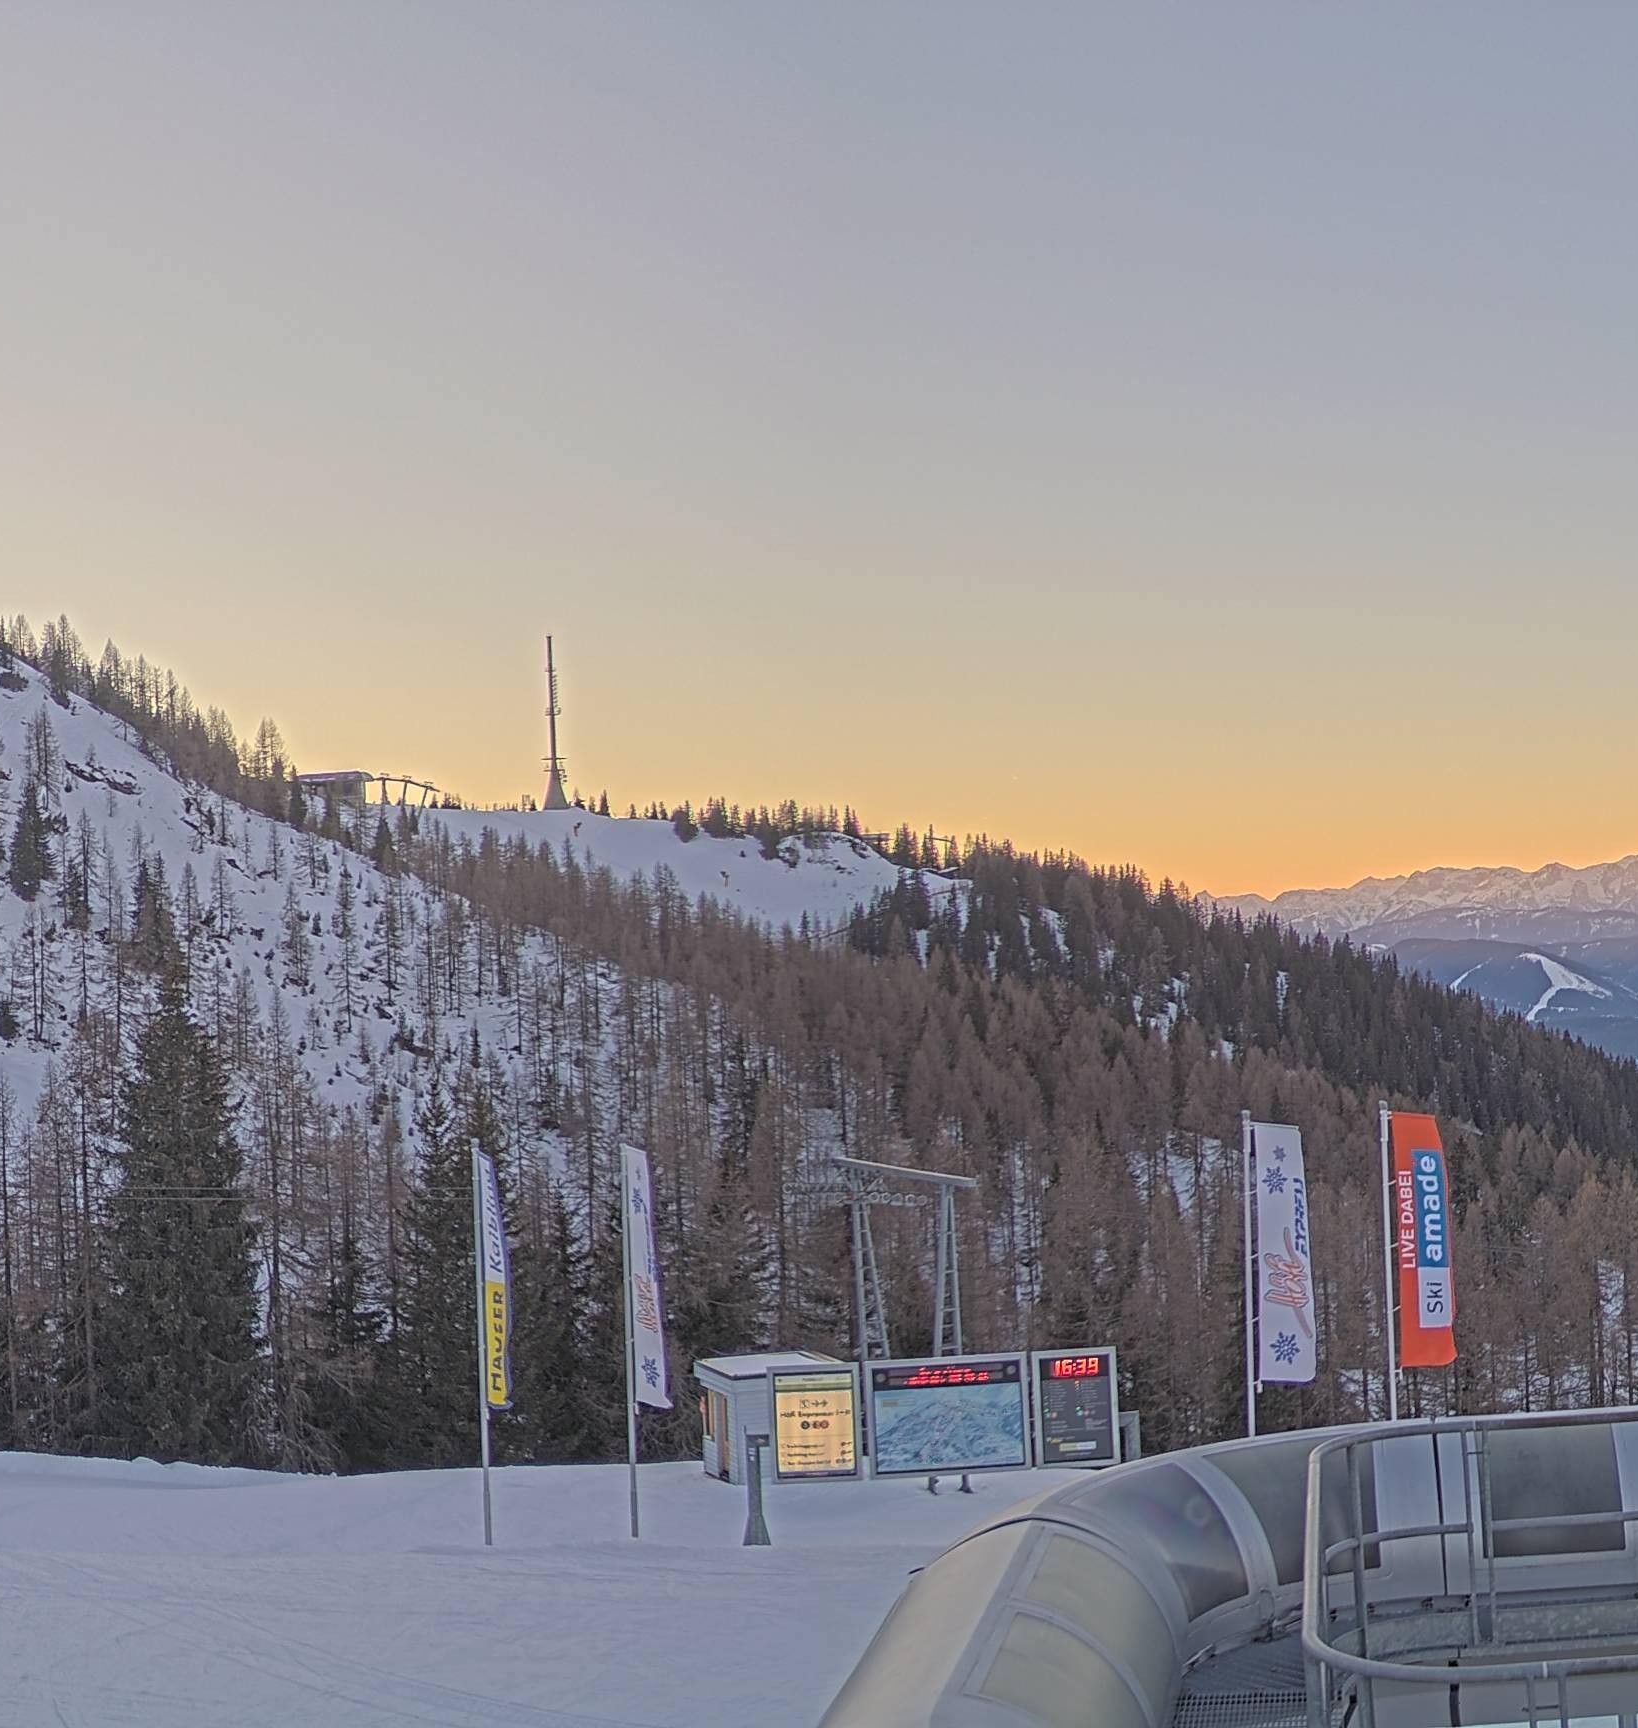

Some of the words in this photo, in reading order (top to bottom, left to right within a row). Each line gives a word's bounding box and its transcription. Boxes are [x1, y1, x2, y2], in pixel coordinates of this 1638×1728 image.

[1398, 1170, 1415, 1225] DABEI
[1401, 1228, 1416, 1269] LIVE
[1427, 1282, 1443, 1313] Ski
[1054, 1358, 1099, 1377] 16:39
